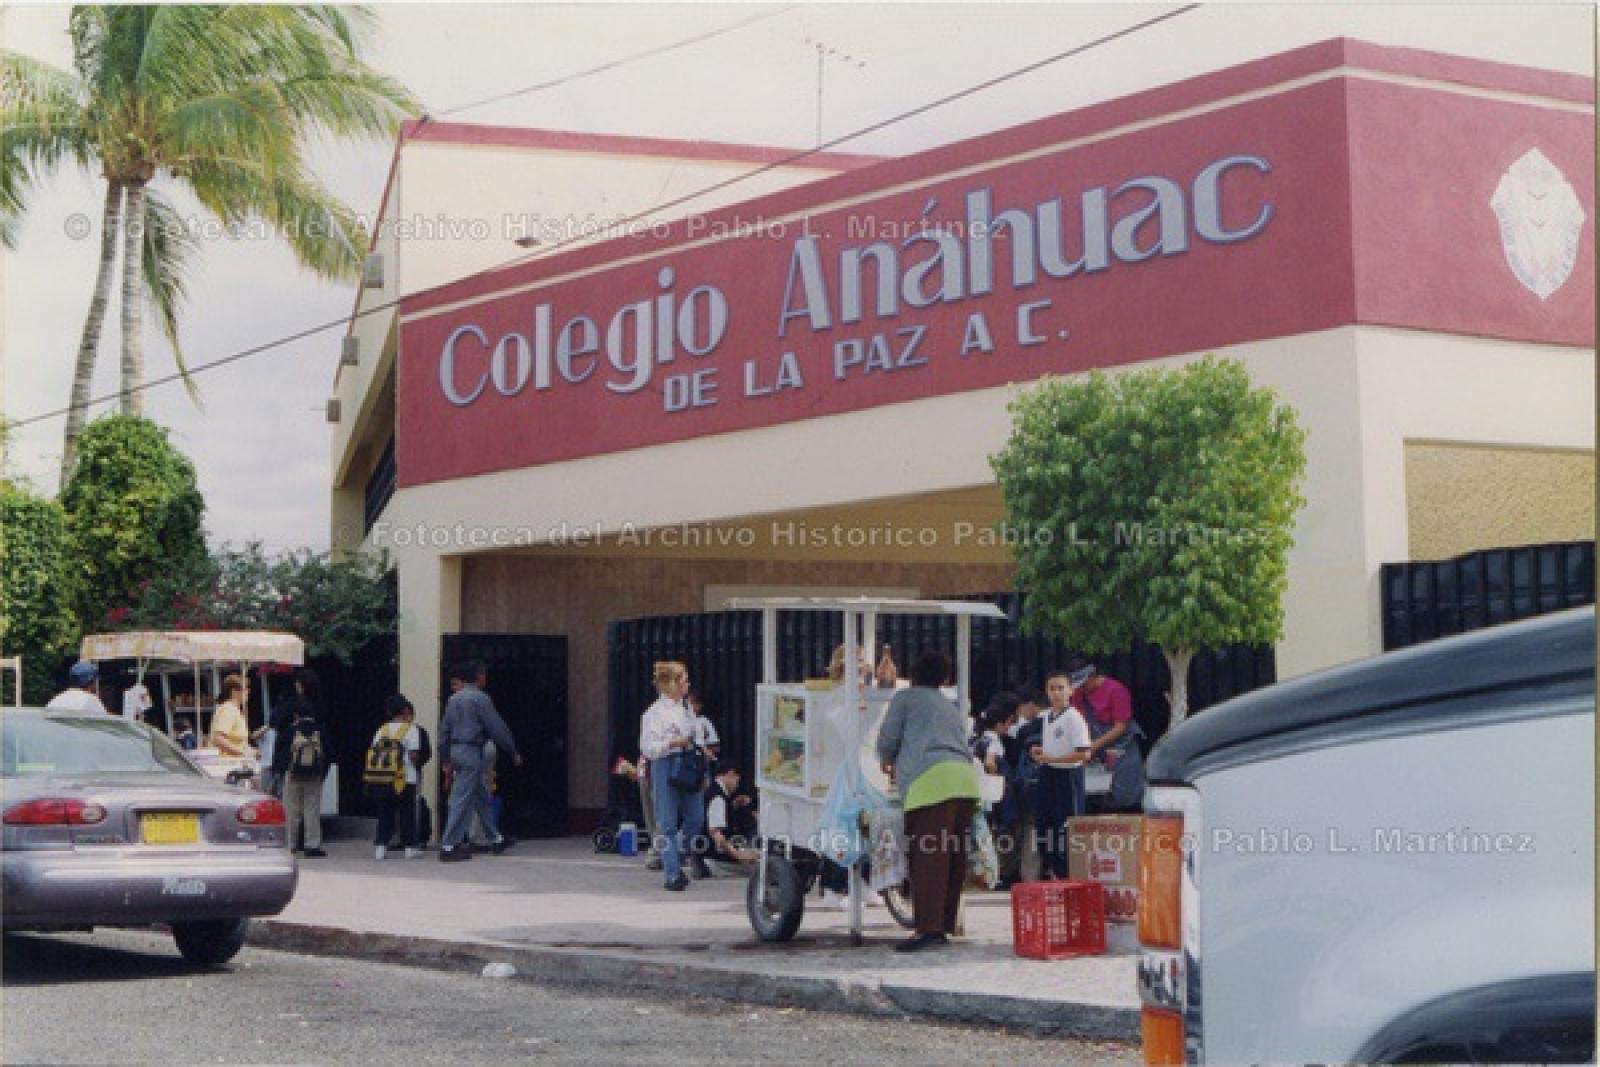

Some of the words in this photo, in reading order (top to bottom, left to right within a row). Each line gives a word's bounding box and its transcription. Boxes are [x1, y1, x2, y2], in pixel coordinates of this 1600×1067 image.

[438, 265, 728, 408] Colegio
[778, 154, 1275, 337] Anáhuac
[663, 367, 720, 413] DE
[743, 351, 804, 397] LA
[833, 324, 929, 380] PAZ
[960, 311, 994, 356] A
[1015, 298, 1070, 346] C.
